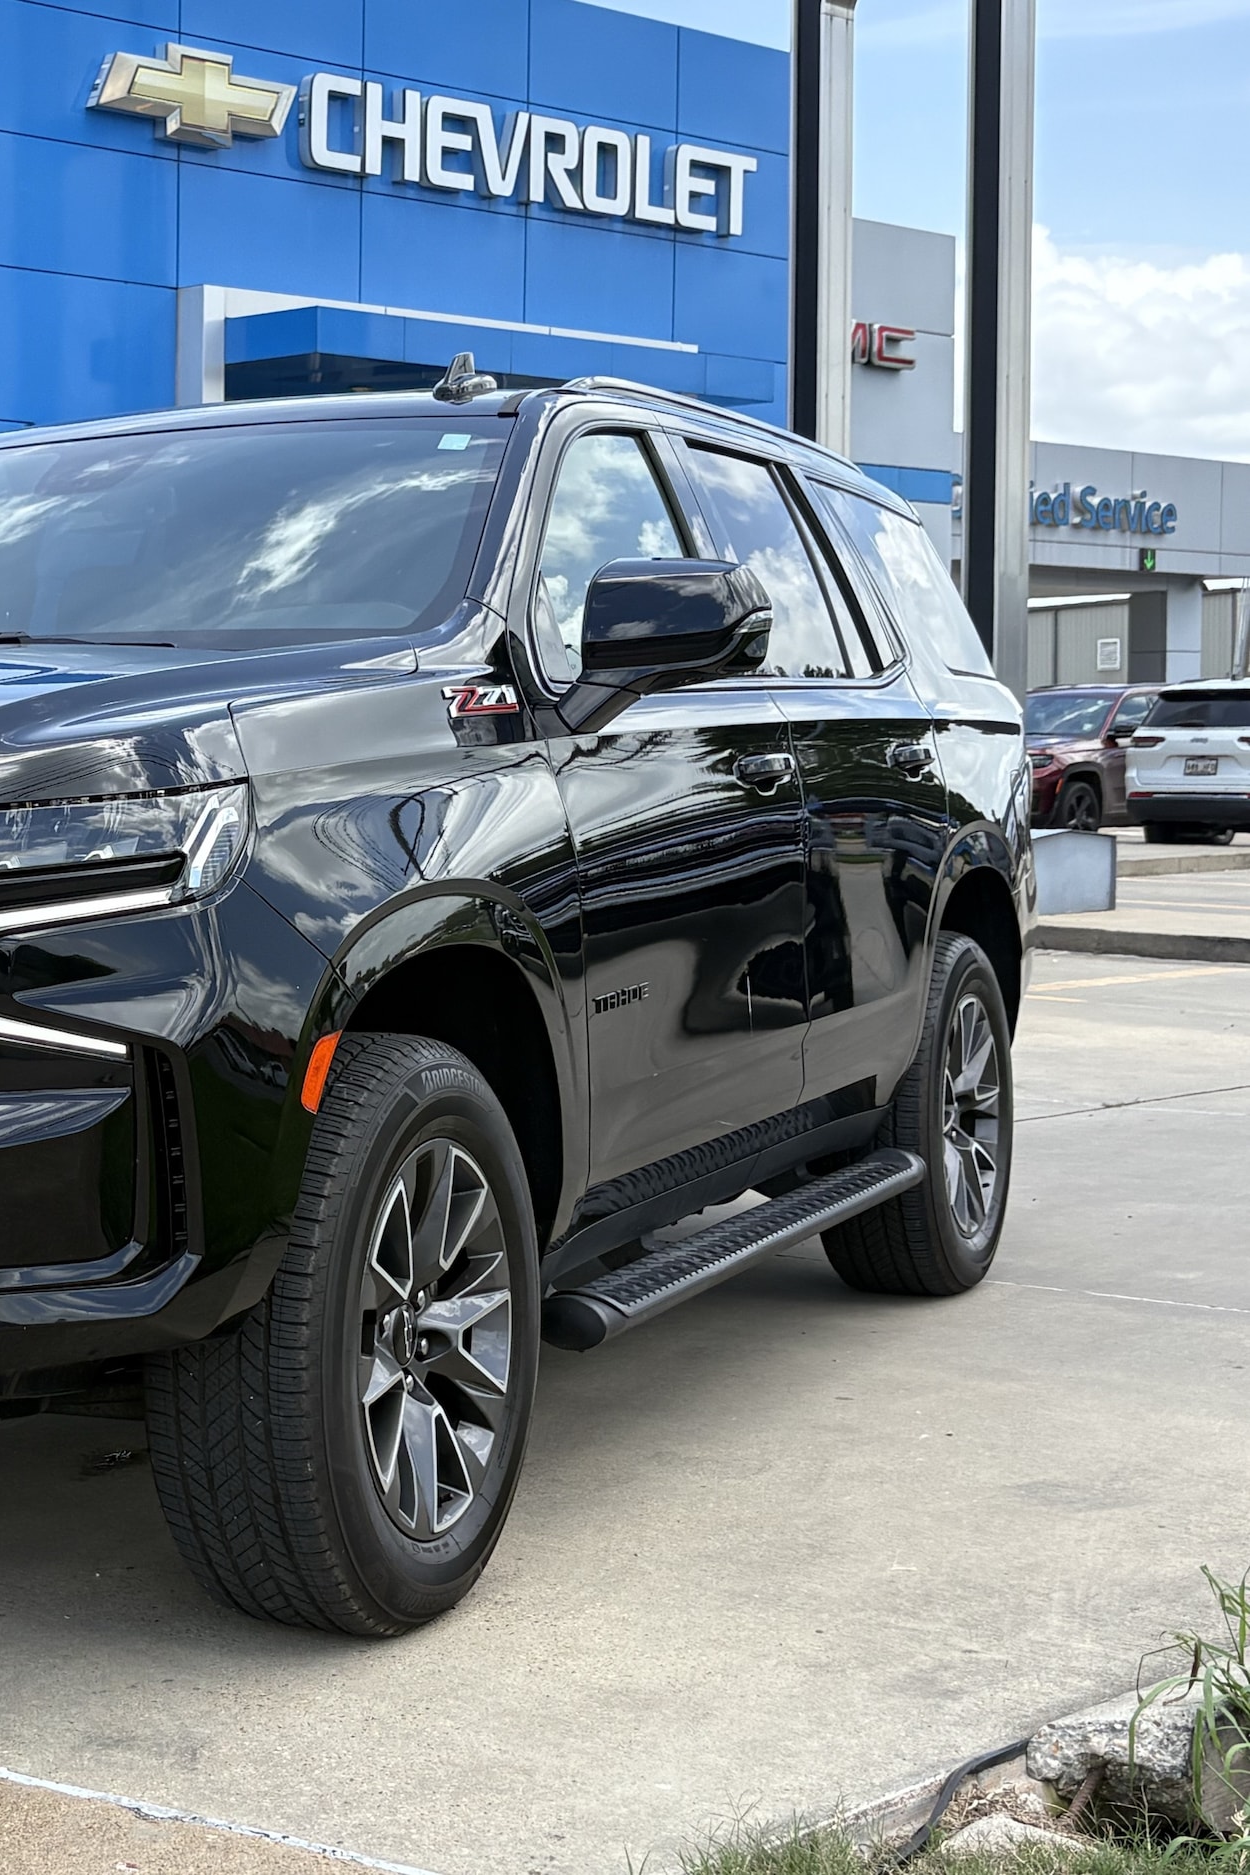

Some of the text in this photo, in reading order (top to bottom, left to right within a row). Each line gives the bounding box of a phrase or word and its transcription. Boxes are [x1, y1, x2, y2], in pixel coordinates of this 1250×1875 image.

[299, 72, 757, 237] CHEVROLET
[1074, 485, 1178, 534] Service
[441, 684, 520, 718] Z71
